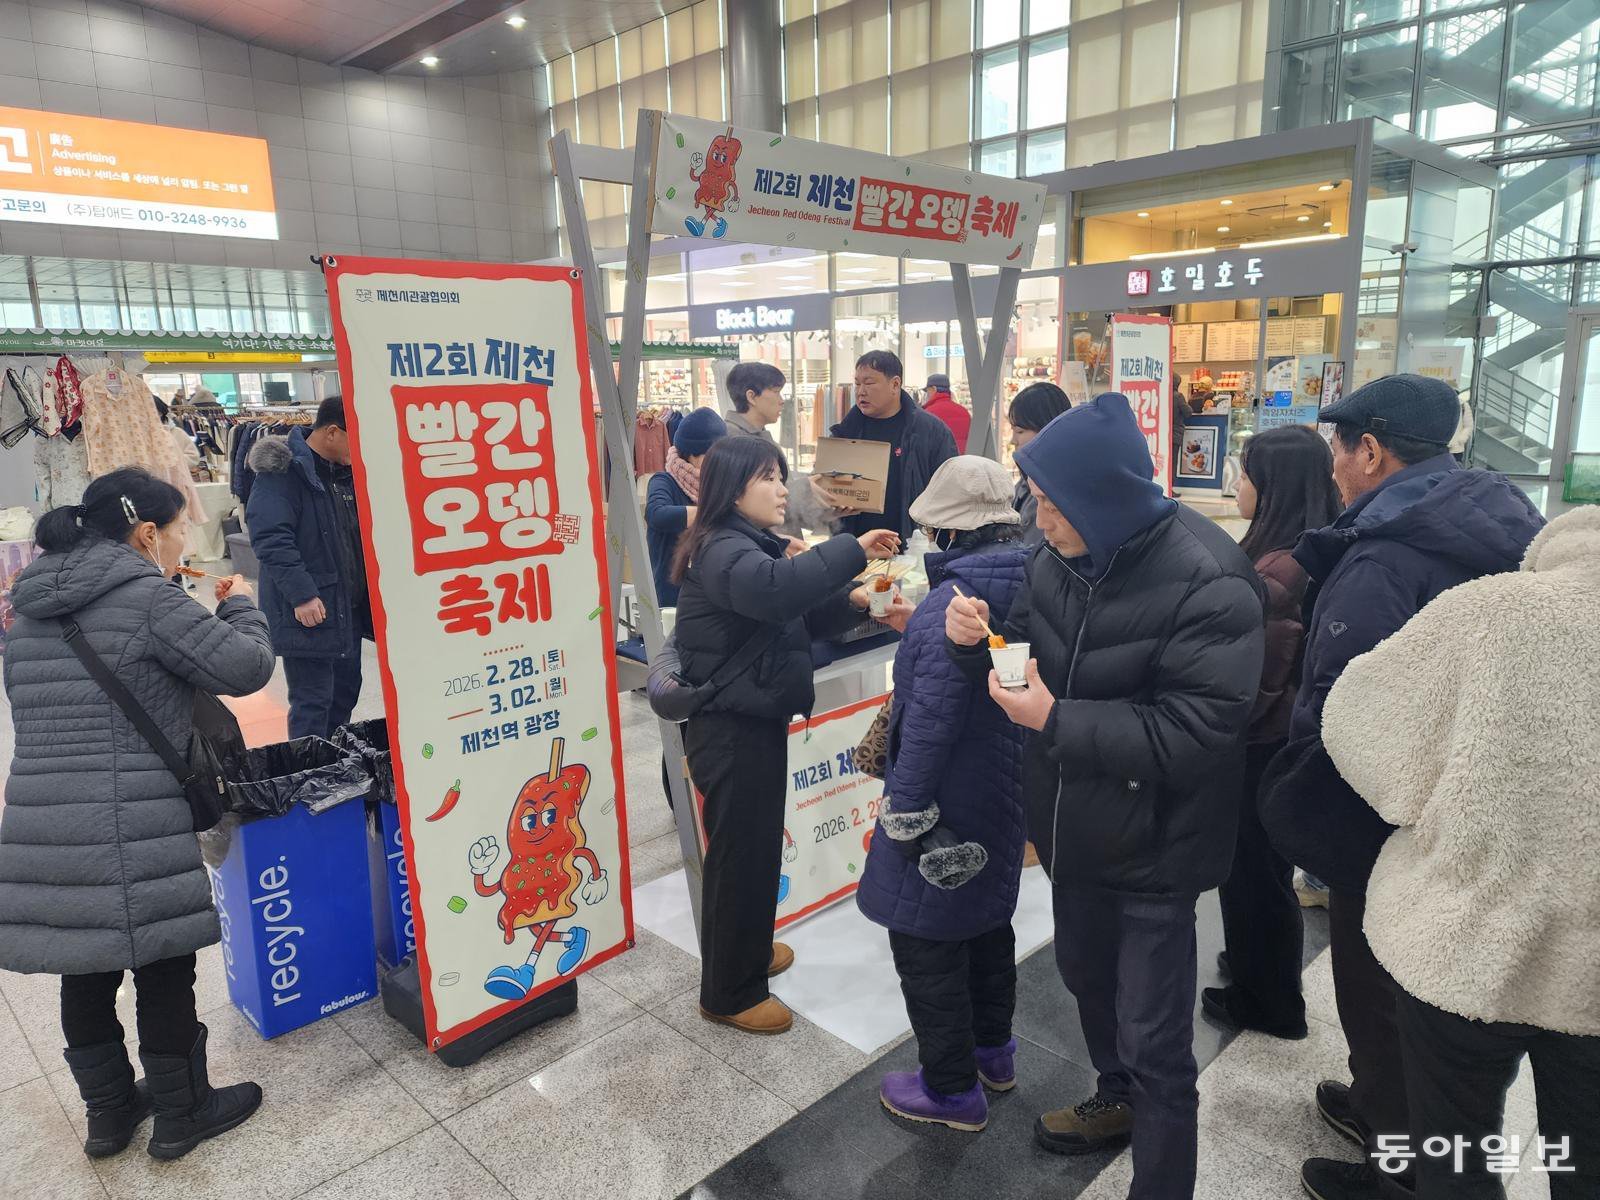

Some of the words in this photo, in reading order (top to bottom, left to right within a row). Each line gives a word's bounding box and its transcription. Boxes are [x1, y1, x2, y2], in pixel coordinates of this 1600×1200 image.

[51, 148, 117, 166] Advertising
[0, 198, 46, 214] 고문의
[138, 209, 248, 229] 010-3248-9936
[747, 204, 781, 218] Jecheon
[782, 208, 798, 219] Red
[798, 210, 822, 224] Odeng
[823, 214, 851, 227] Festival
[753, 168, 802, 199] 제2회
[806, 174, 856, 212] 제천
[860, 183, 915, 229] 빨간
[914, 193, 966, 235] 오뎅
[970, 194, 1020, 240] 축제
[1157, 257, 1264, 293] 호밀호두
[376, 289, 461, 304] 제천시관광협의회
[716, 309, 755, 330] Black
[756, 305, 795, 327] Bear
[222, 338, 260, 350] 여기다!
[262, 339, 284, 350] 기분
[386, 342, 478, 378] 제2회
[484, 337, 556, 387] 제천
[1120, 358, 1143, 378] 제2회
[1144, 356, 1164, 383] 제천
[405, 397, 545, 479] 빨간
[422, 476, 552, 555] 오뎅
[436, 563, 553, 637] 축제
[547, 649, 560, 664] 토
[548, 664, 561, 672] Sat.
[443, 673, 484, 697] 2026.
[485, 664, 506, 687] 2.
[507, 656, 540, 681] 28.
[549, 676, 562, 692] 월
[488, 693, 509, 715] 3.
[510, 684, 542, 709] 02.
[549, 691, 565, 700] Mon.
[460, 720, 519, 755] 제천역
[524, 709, 561, 737] 광장
[792, 759, 833, 792] 제2회
[795, 794, 823, 811] Jecheon
[823, 787, 837, 798] Red
[813, 815, 850, 843] 2026.
[851, 807, 865, 827] 2.
[251, 855, 305, 1007] recycle.
